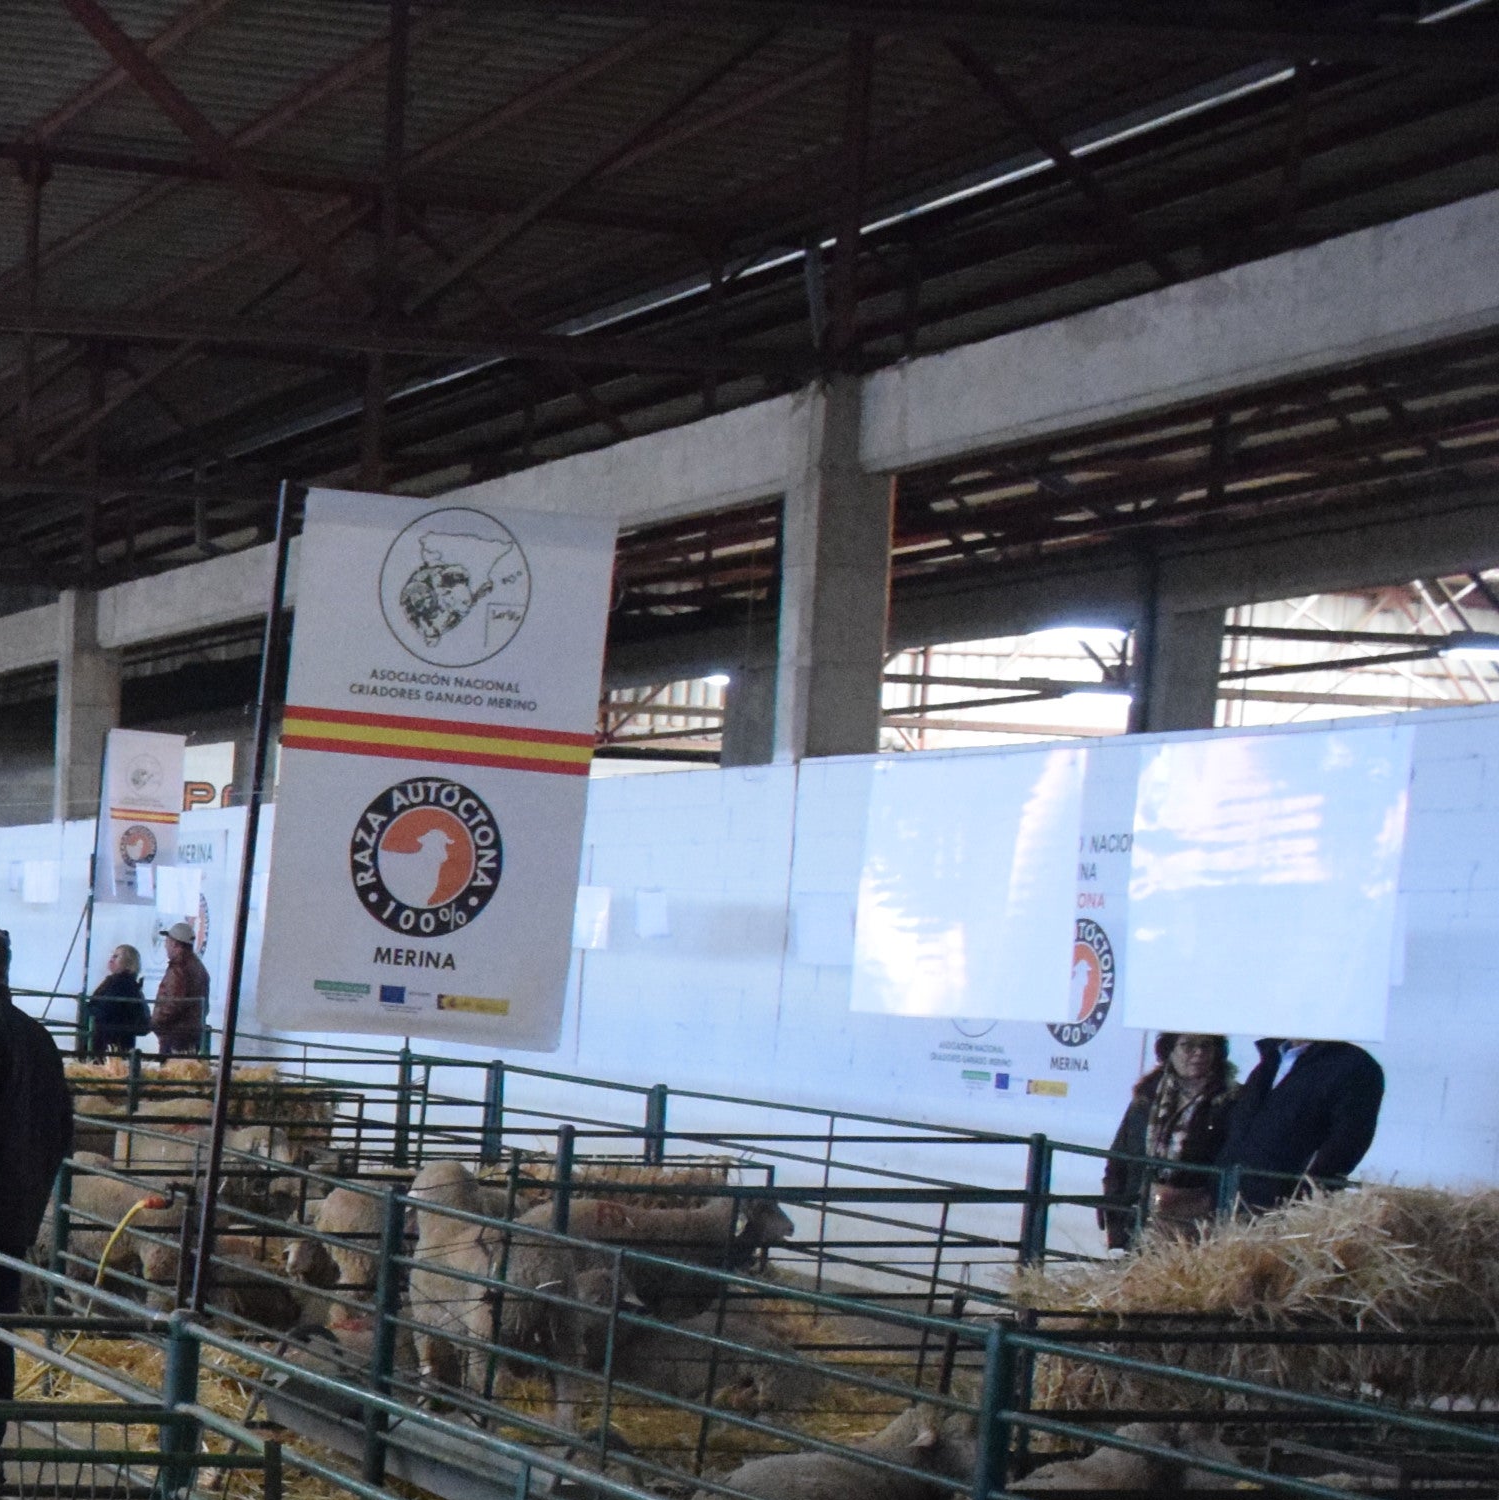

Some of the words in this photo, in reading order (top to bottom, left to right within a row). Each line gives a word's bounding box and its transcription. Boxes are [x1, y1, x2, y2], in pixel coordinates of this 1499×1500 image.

[368, 668, 451, 687] ASOCIACIÓN
[454, 676, 521, 694] NACIONAL
[348, 683, 421, 701] CRIADORES
[424, 691, 484, 708] GANADO
[486, 697, 538, 712] MERINO
[353, 812, 388, 888] RAZA
[391, 780, 499, 887] AUTÓCTONA
[381, 899, 468, 934] 100%
[372, 946, 457, 971] MERINA
[1049, 1056, 1091, 1073] MERINA
